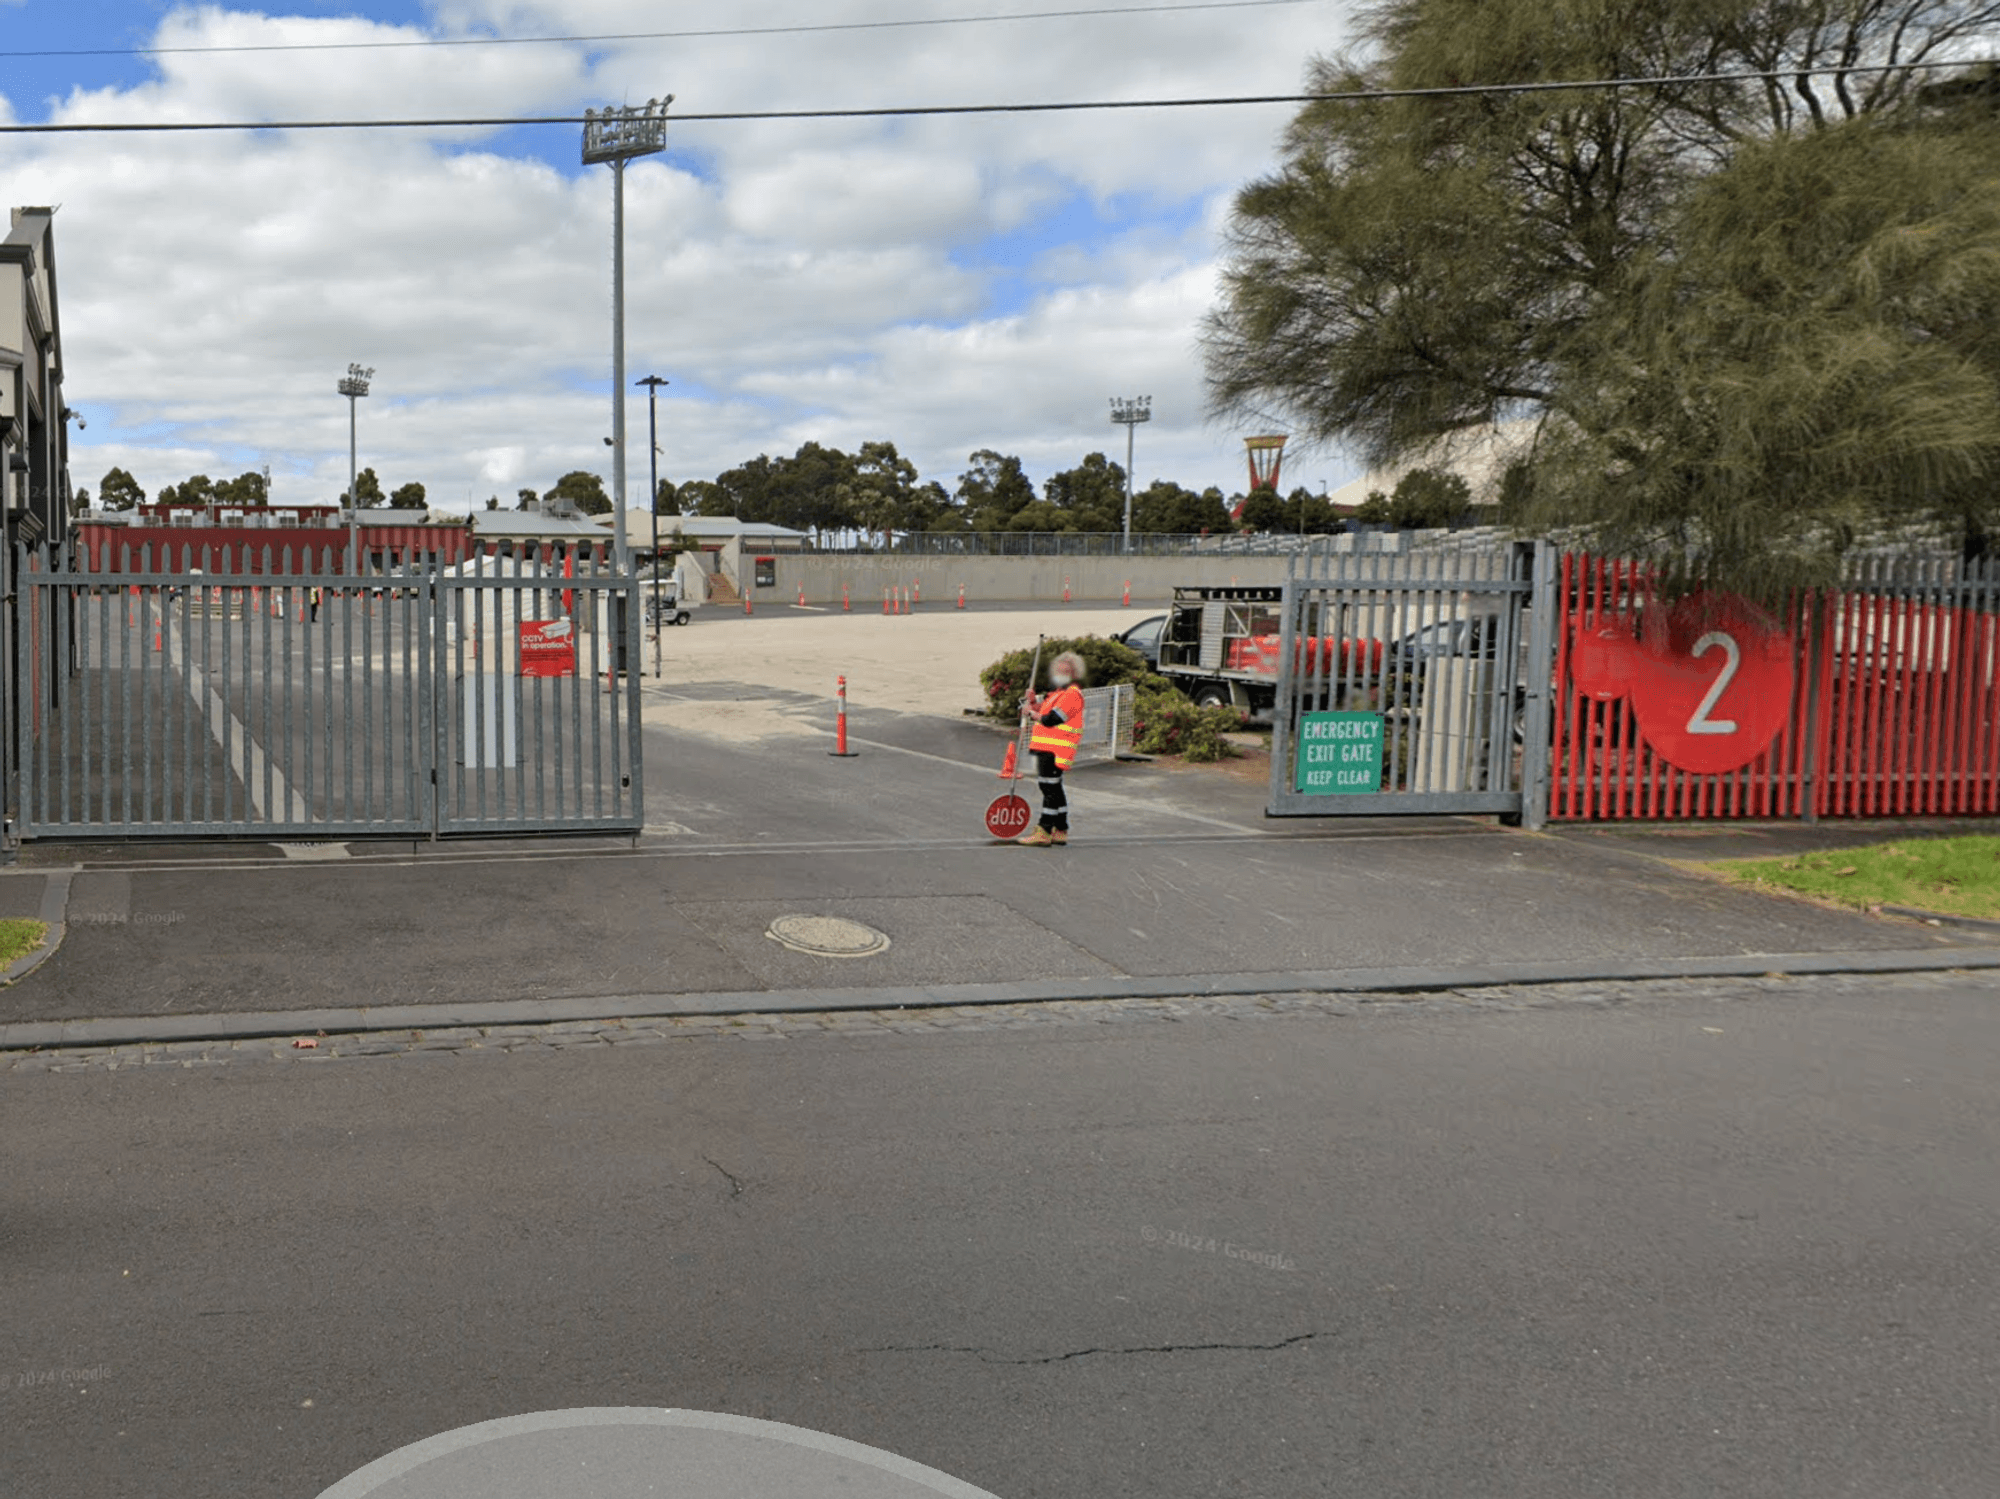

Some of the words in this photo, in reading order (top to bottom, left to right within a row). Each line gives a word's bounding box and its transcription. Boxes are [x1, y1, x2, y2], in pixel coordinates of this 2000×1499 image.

[1686, 631, 1740, 734] 2
[1304, 720, 1379, 739] EMERGENCY
[1307, 744, 1335, 762] EXIT
[1341, 744, 1374, 762] GATE
[1306, 770, 1333, 785] KEEP
[1337, 770, 1371, 785] CLEAR
[990, 807, 1026, 825] STOP
